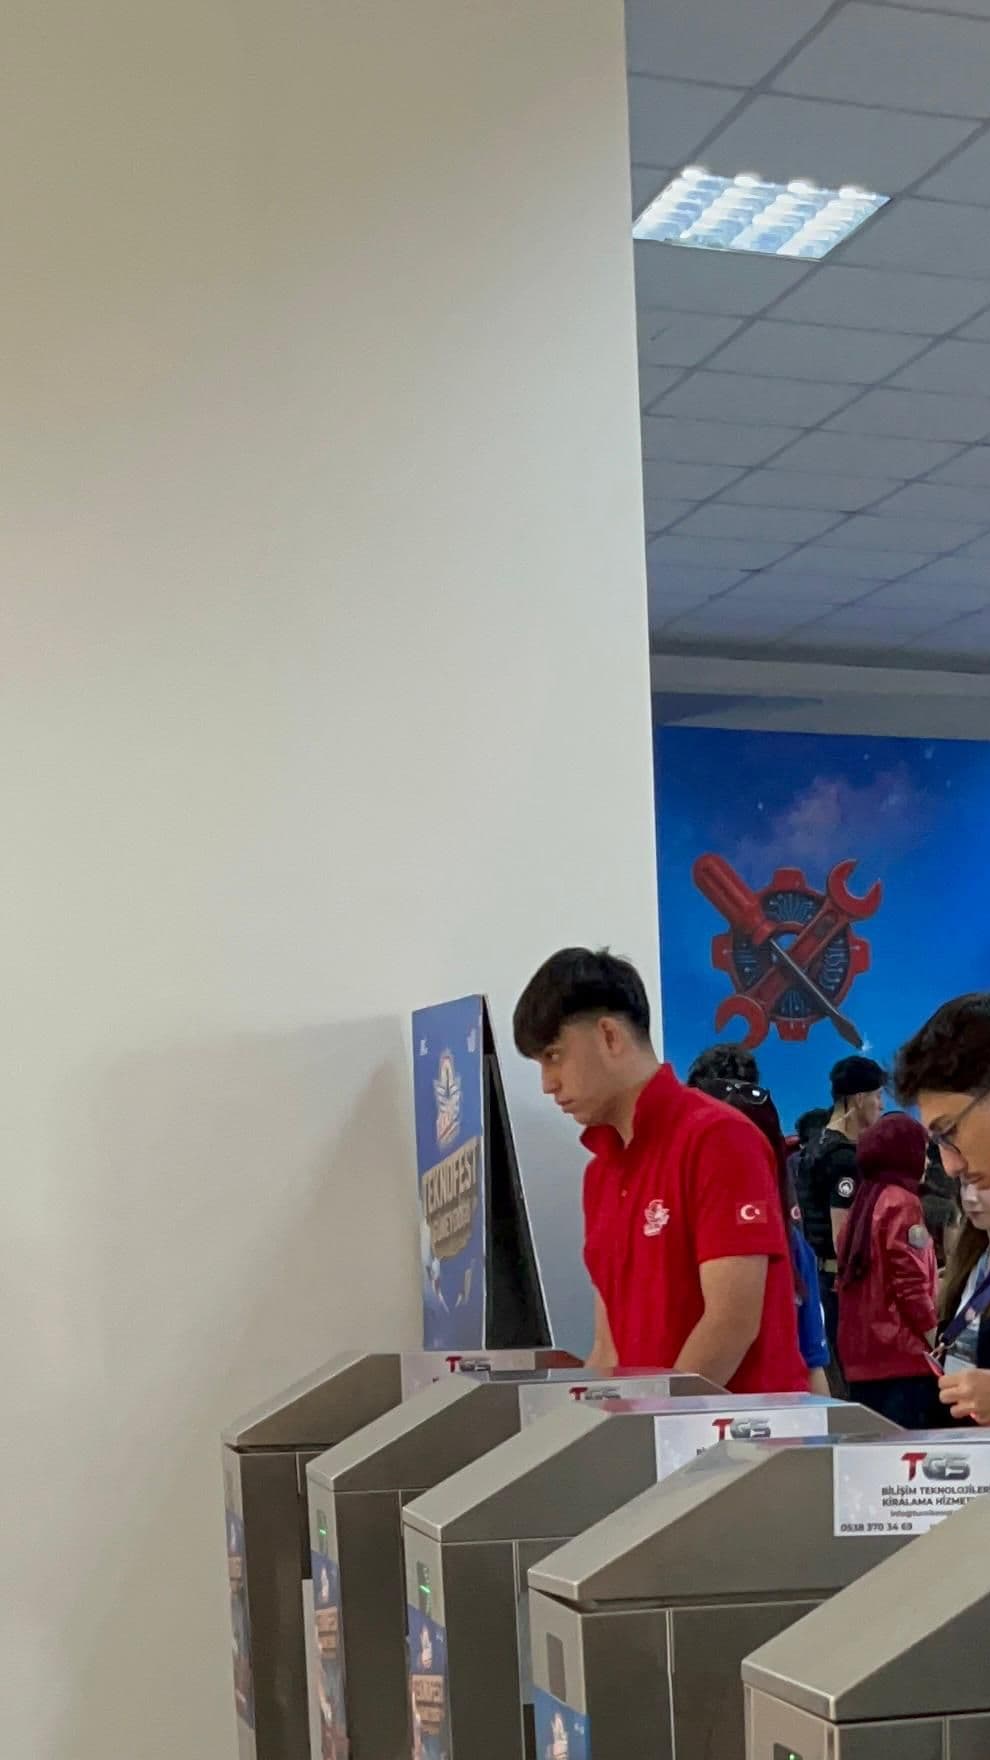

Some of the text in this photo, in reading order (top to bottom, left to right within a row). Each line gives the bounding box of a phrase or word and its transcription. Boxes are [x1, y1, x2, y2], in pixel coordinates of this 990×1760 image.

[712, 1418, 771, 1440] TGS
[901, 1452, 971, 1481] TGS
[881, 1485, 917, 1496] BİLİŞİM
[882, 1496, 969, 1507] KİRALAMA HİZME
[840, 1523, 865, 1532] 0538
[867, 1523, 884, 1531] 370
[886, 1522, 899, 1531] 34
